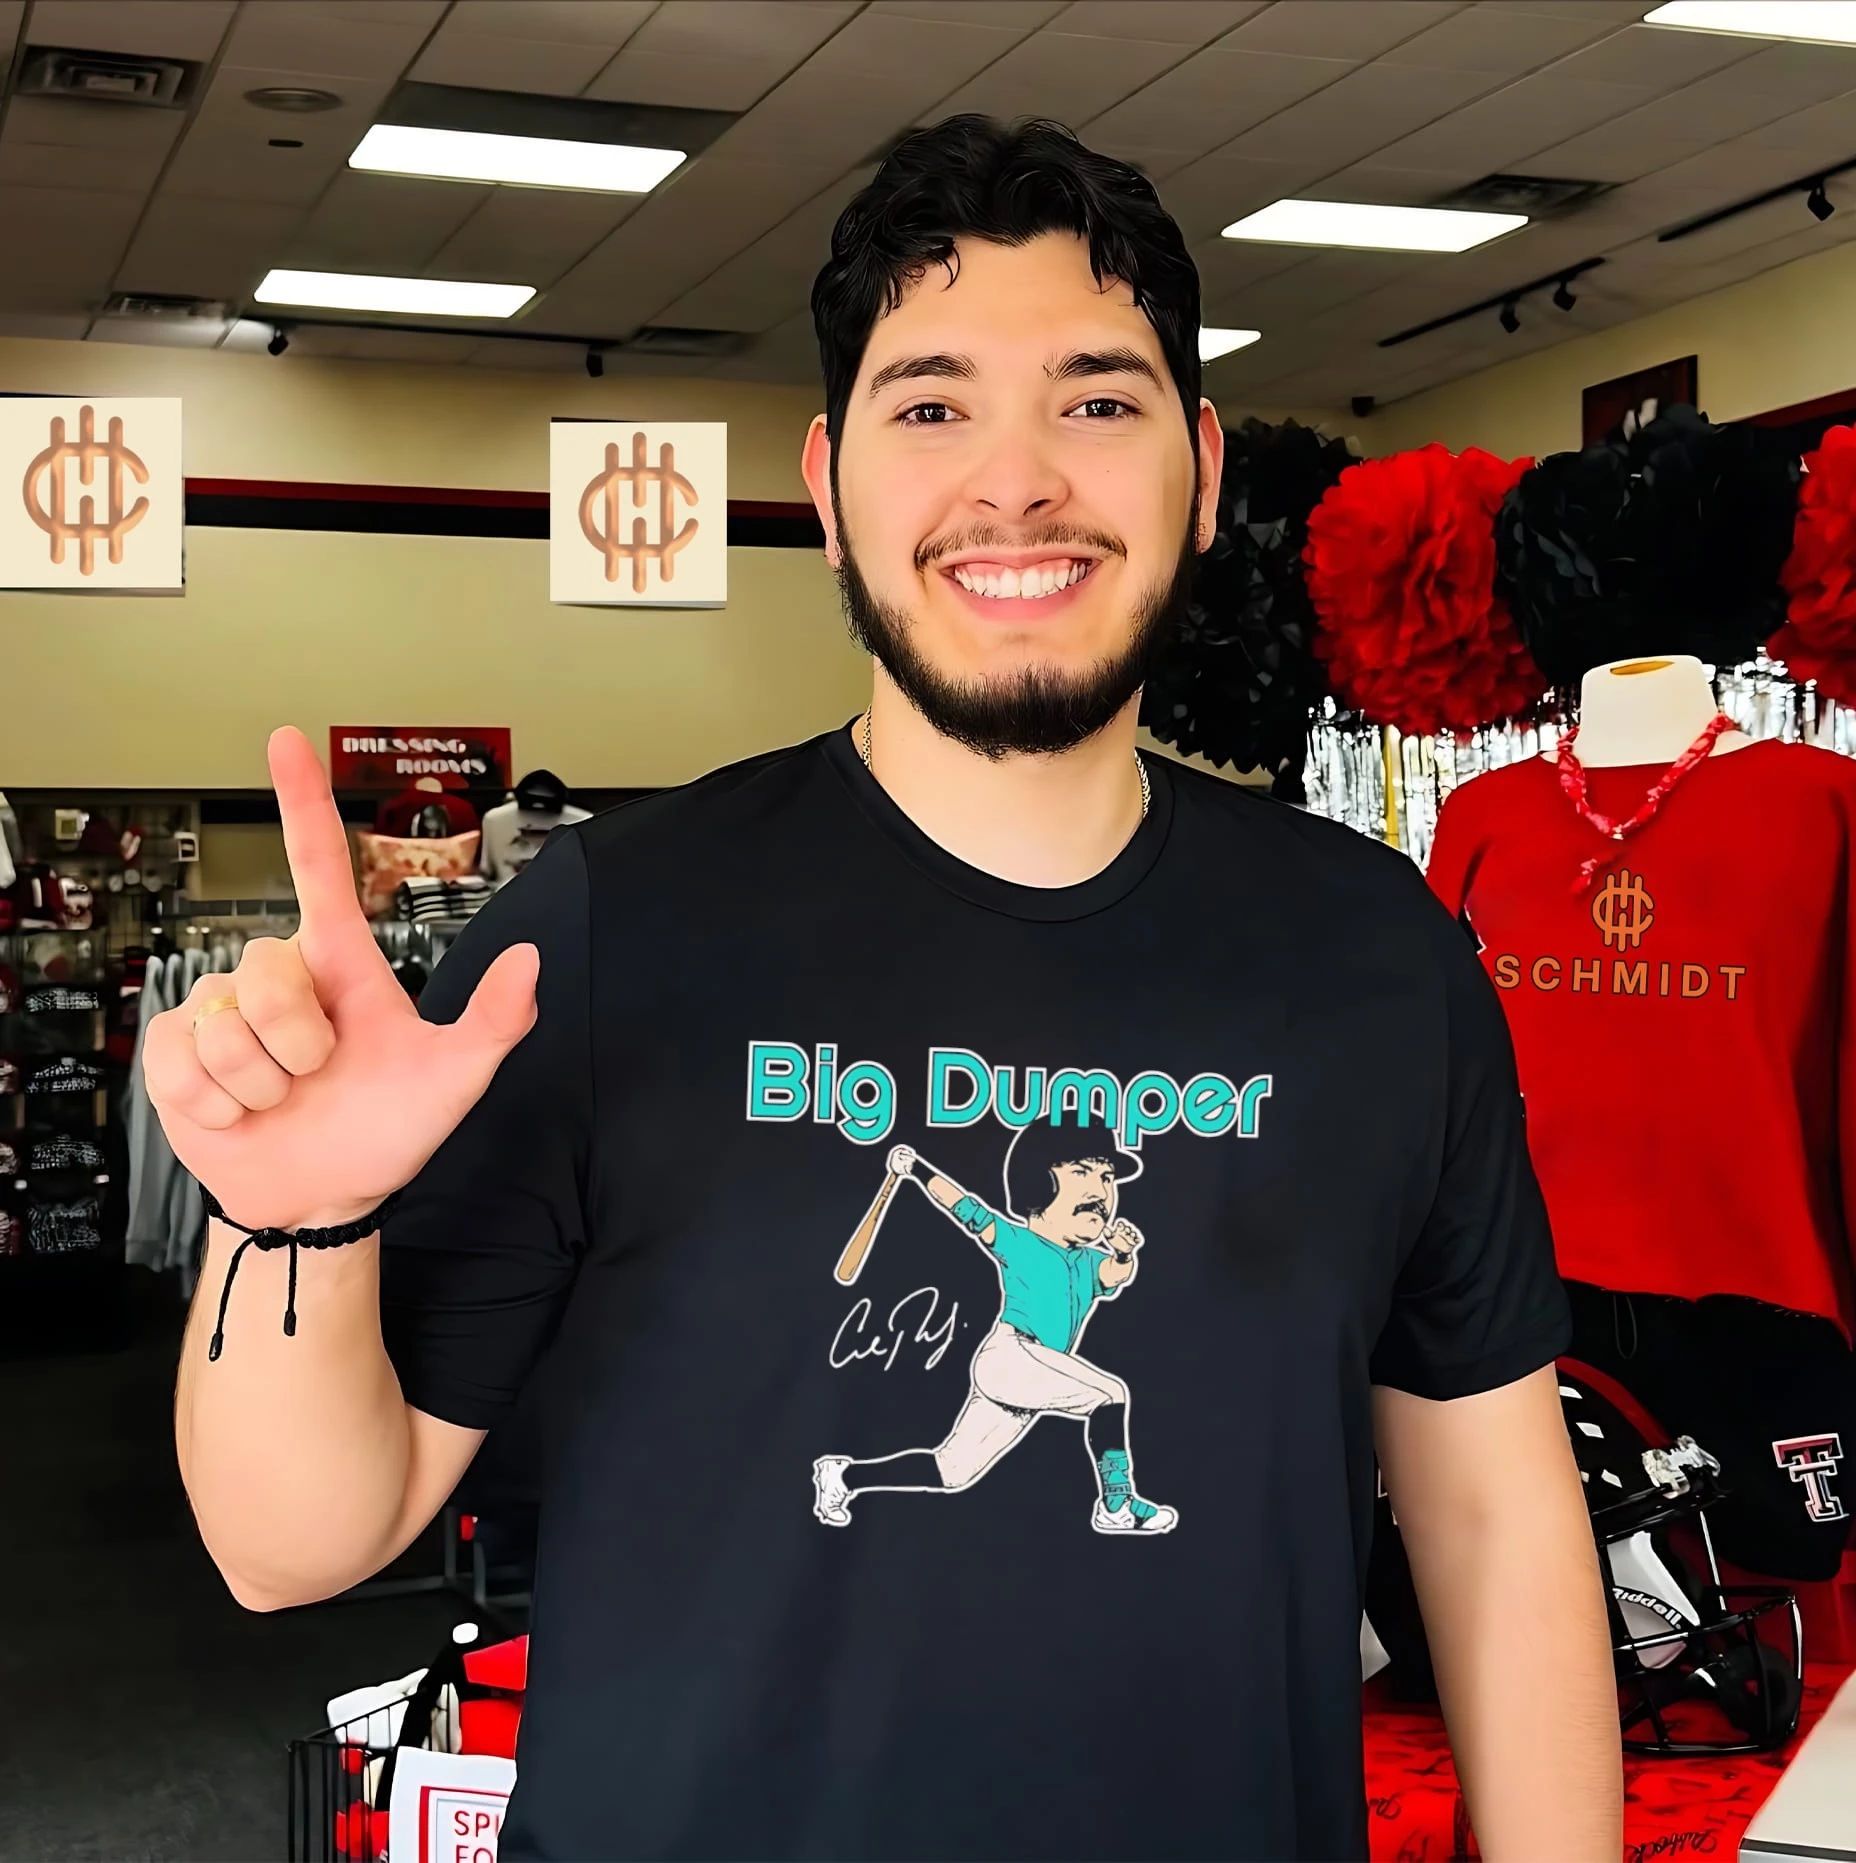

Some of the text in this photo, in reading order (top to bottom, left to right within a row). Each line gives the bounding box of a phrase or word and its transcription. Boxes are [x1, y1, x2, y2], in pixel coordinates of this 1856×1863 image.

[342, 737, 467, 754] DRESSING
[396, 758, 487, 775] ROOMS
[1493, 954, 1747, 1000] SCHMIDT
[746, 1040, 1273, 1150] Big Dumper
